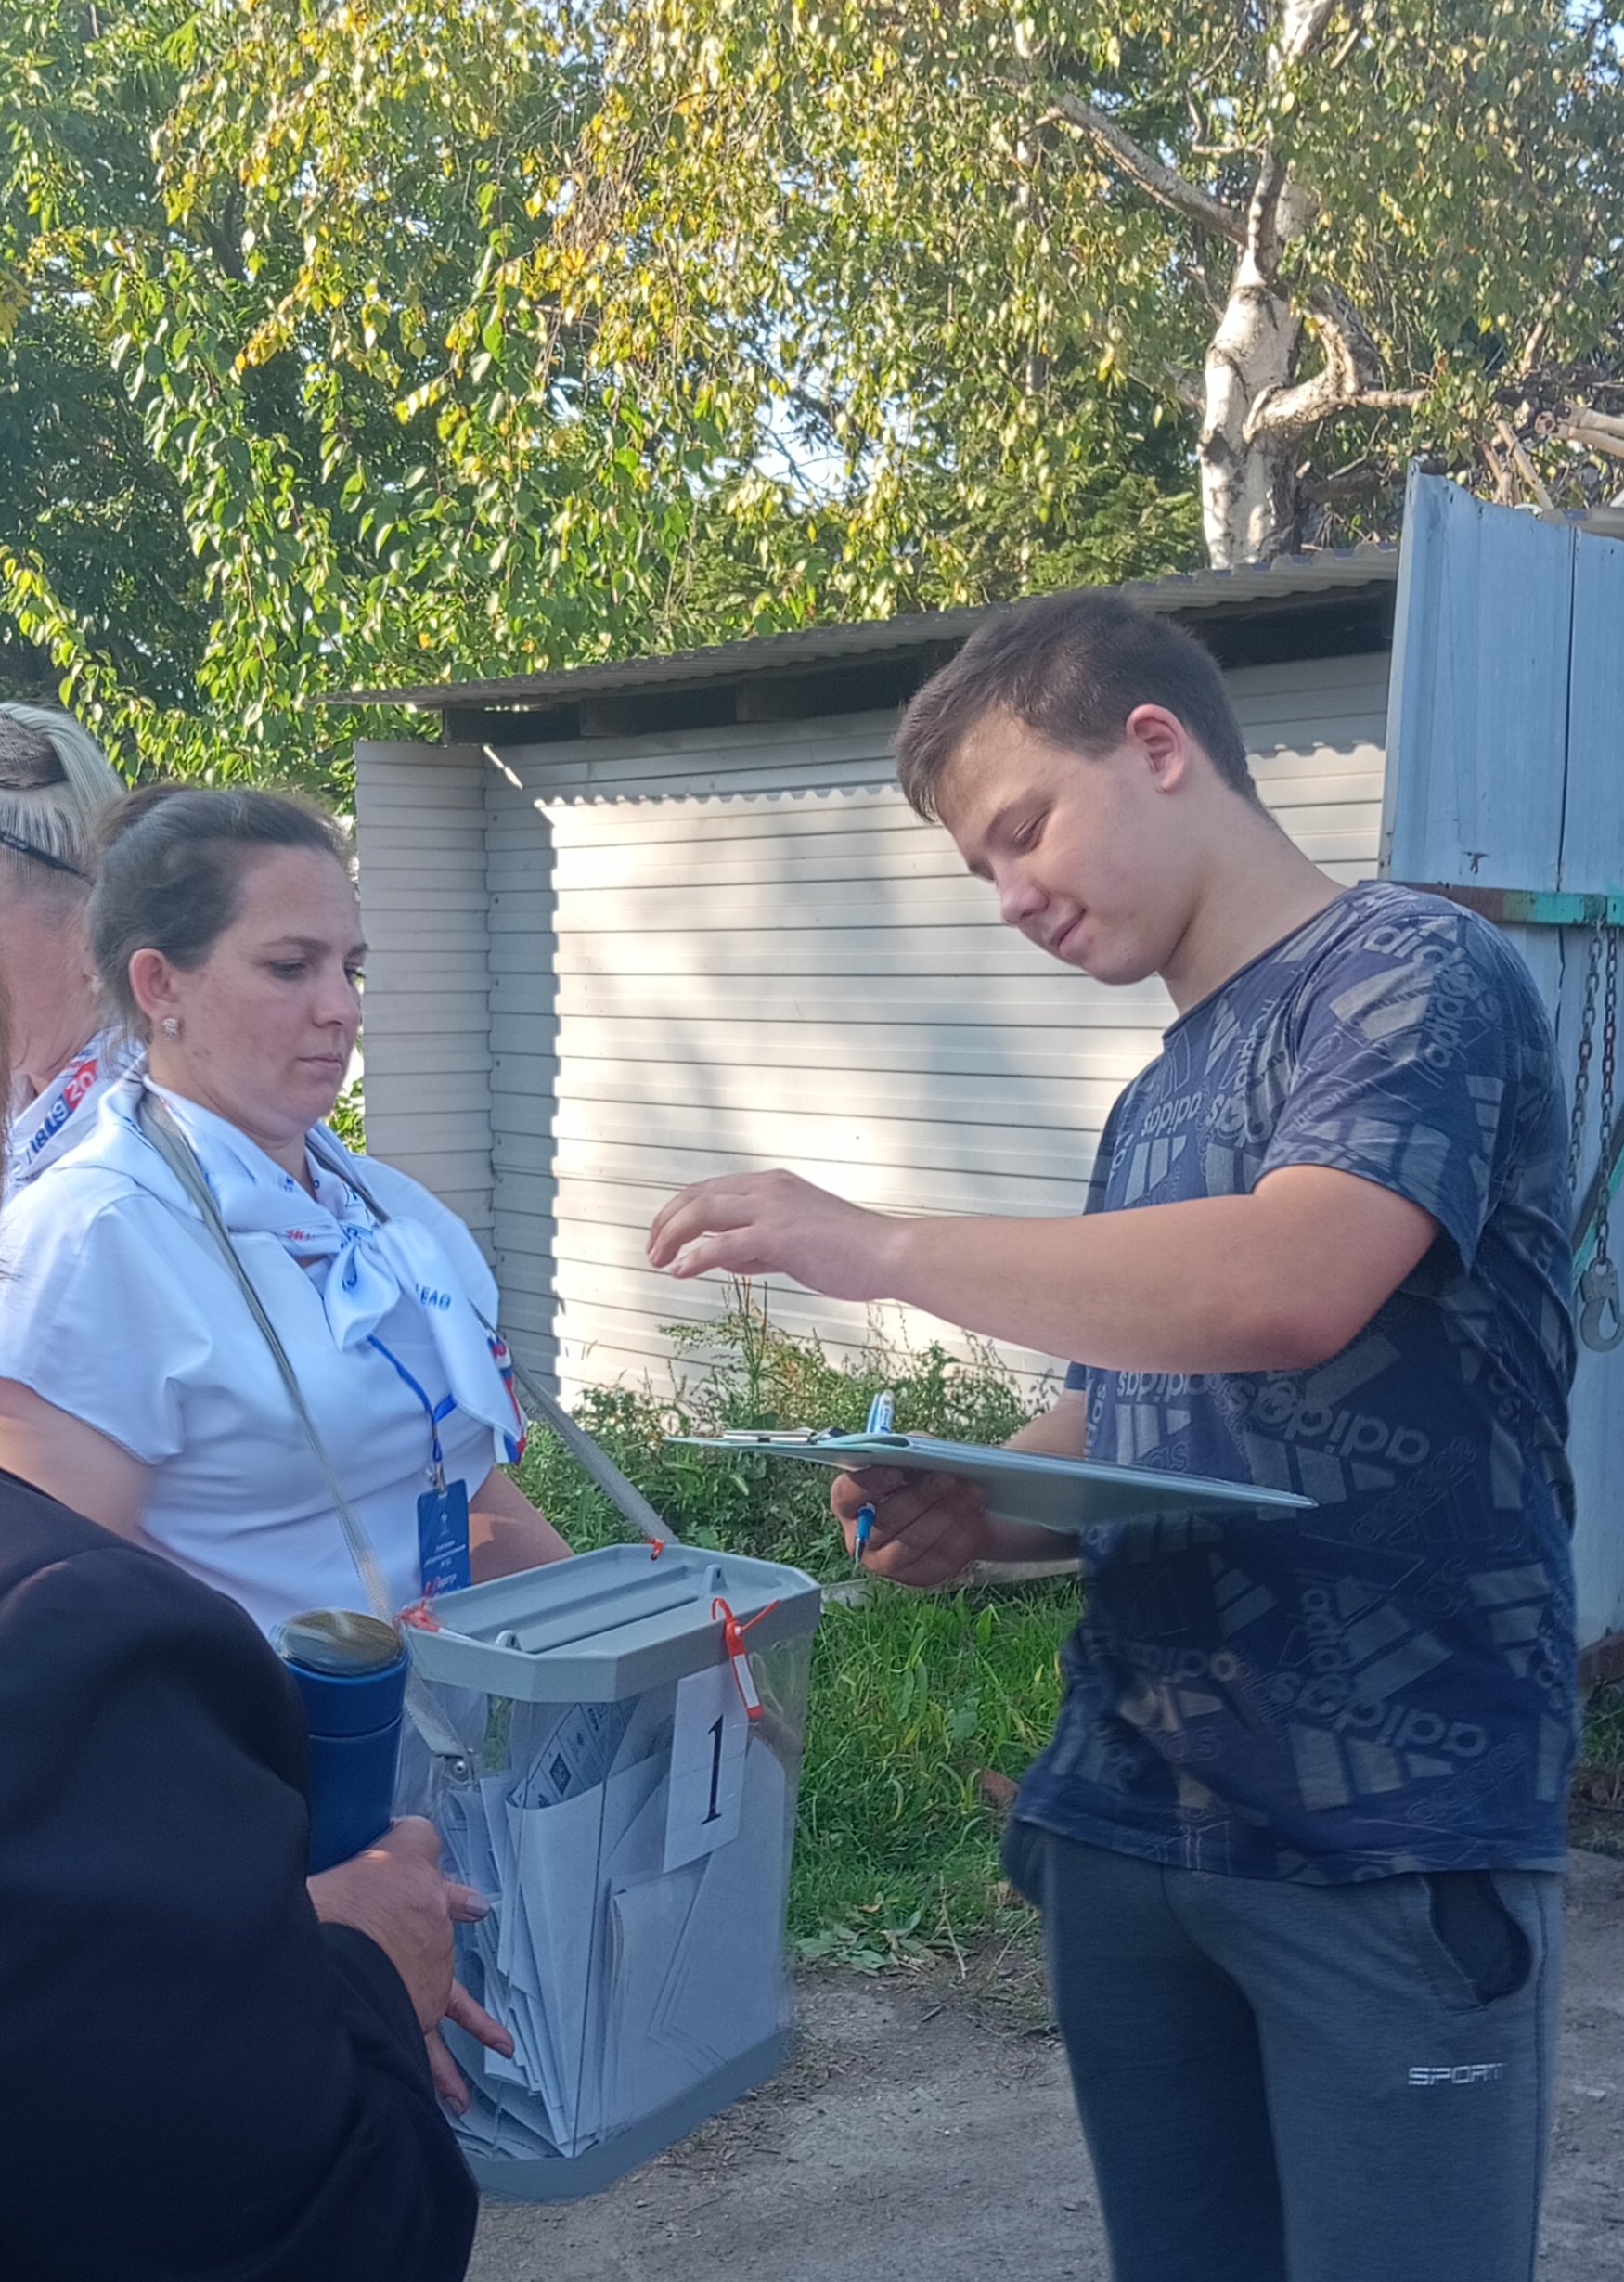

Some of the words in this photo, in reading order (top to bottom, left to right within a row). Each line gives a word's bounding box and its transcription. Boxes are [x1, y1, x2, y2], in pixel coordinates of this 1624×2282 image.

[68, 1071, 95, 1104] 20
[1140, 1090, 1204, 1138] adidas
[701, 1713, 724, 1825] 1
